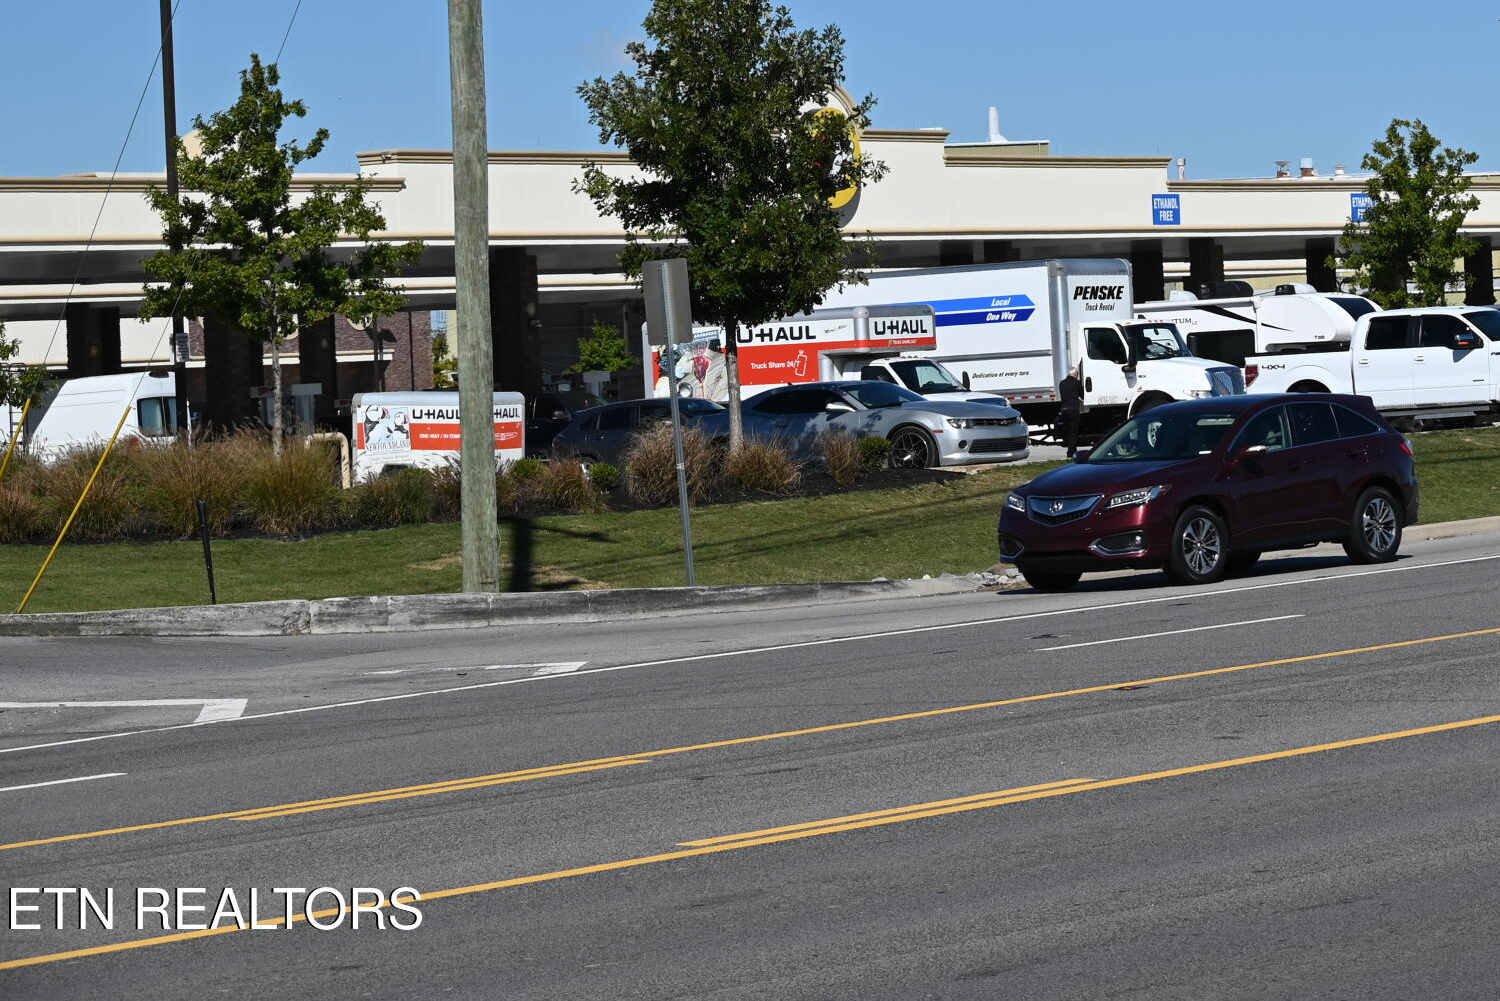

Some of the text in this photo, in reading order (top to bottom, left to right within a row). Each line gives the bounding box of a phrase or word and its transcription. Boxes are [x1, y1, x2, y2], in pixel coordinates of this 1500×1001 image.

[1153, 198, 1179, 209] ETHANOL
[1160, 210, 1174, 221] FREE
[1073, 285, 1125, 300] PENSKE
[991, 297, 1011, 307] Local
[1085, 302, 1115, 311] Truck Rental
[986, 311, 1017, 321] One Way
[874, 319, 928, 335] U-HAUL
[736, 325, 817, 344] U-HAUL
[751, 361, 768, 370] Truck
[768, 361, 786, 369] Share
